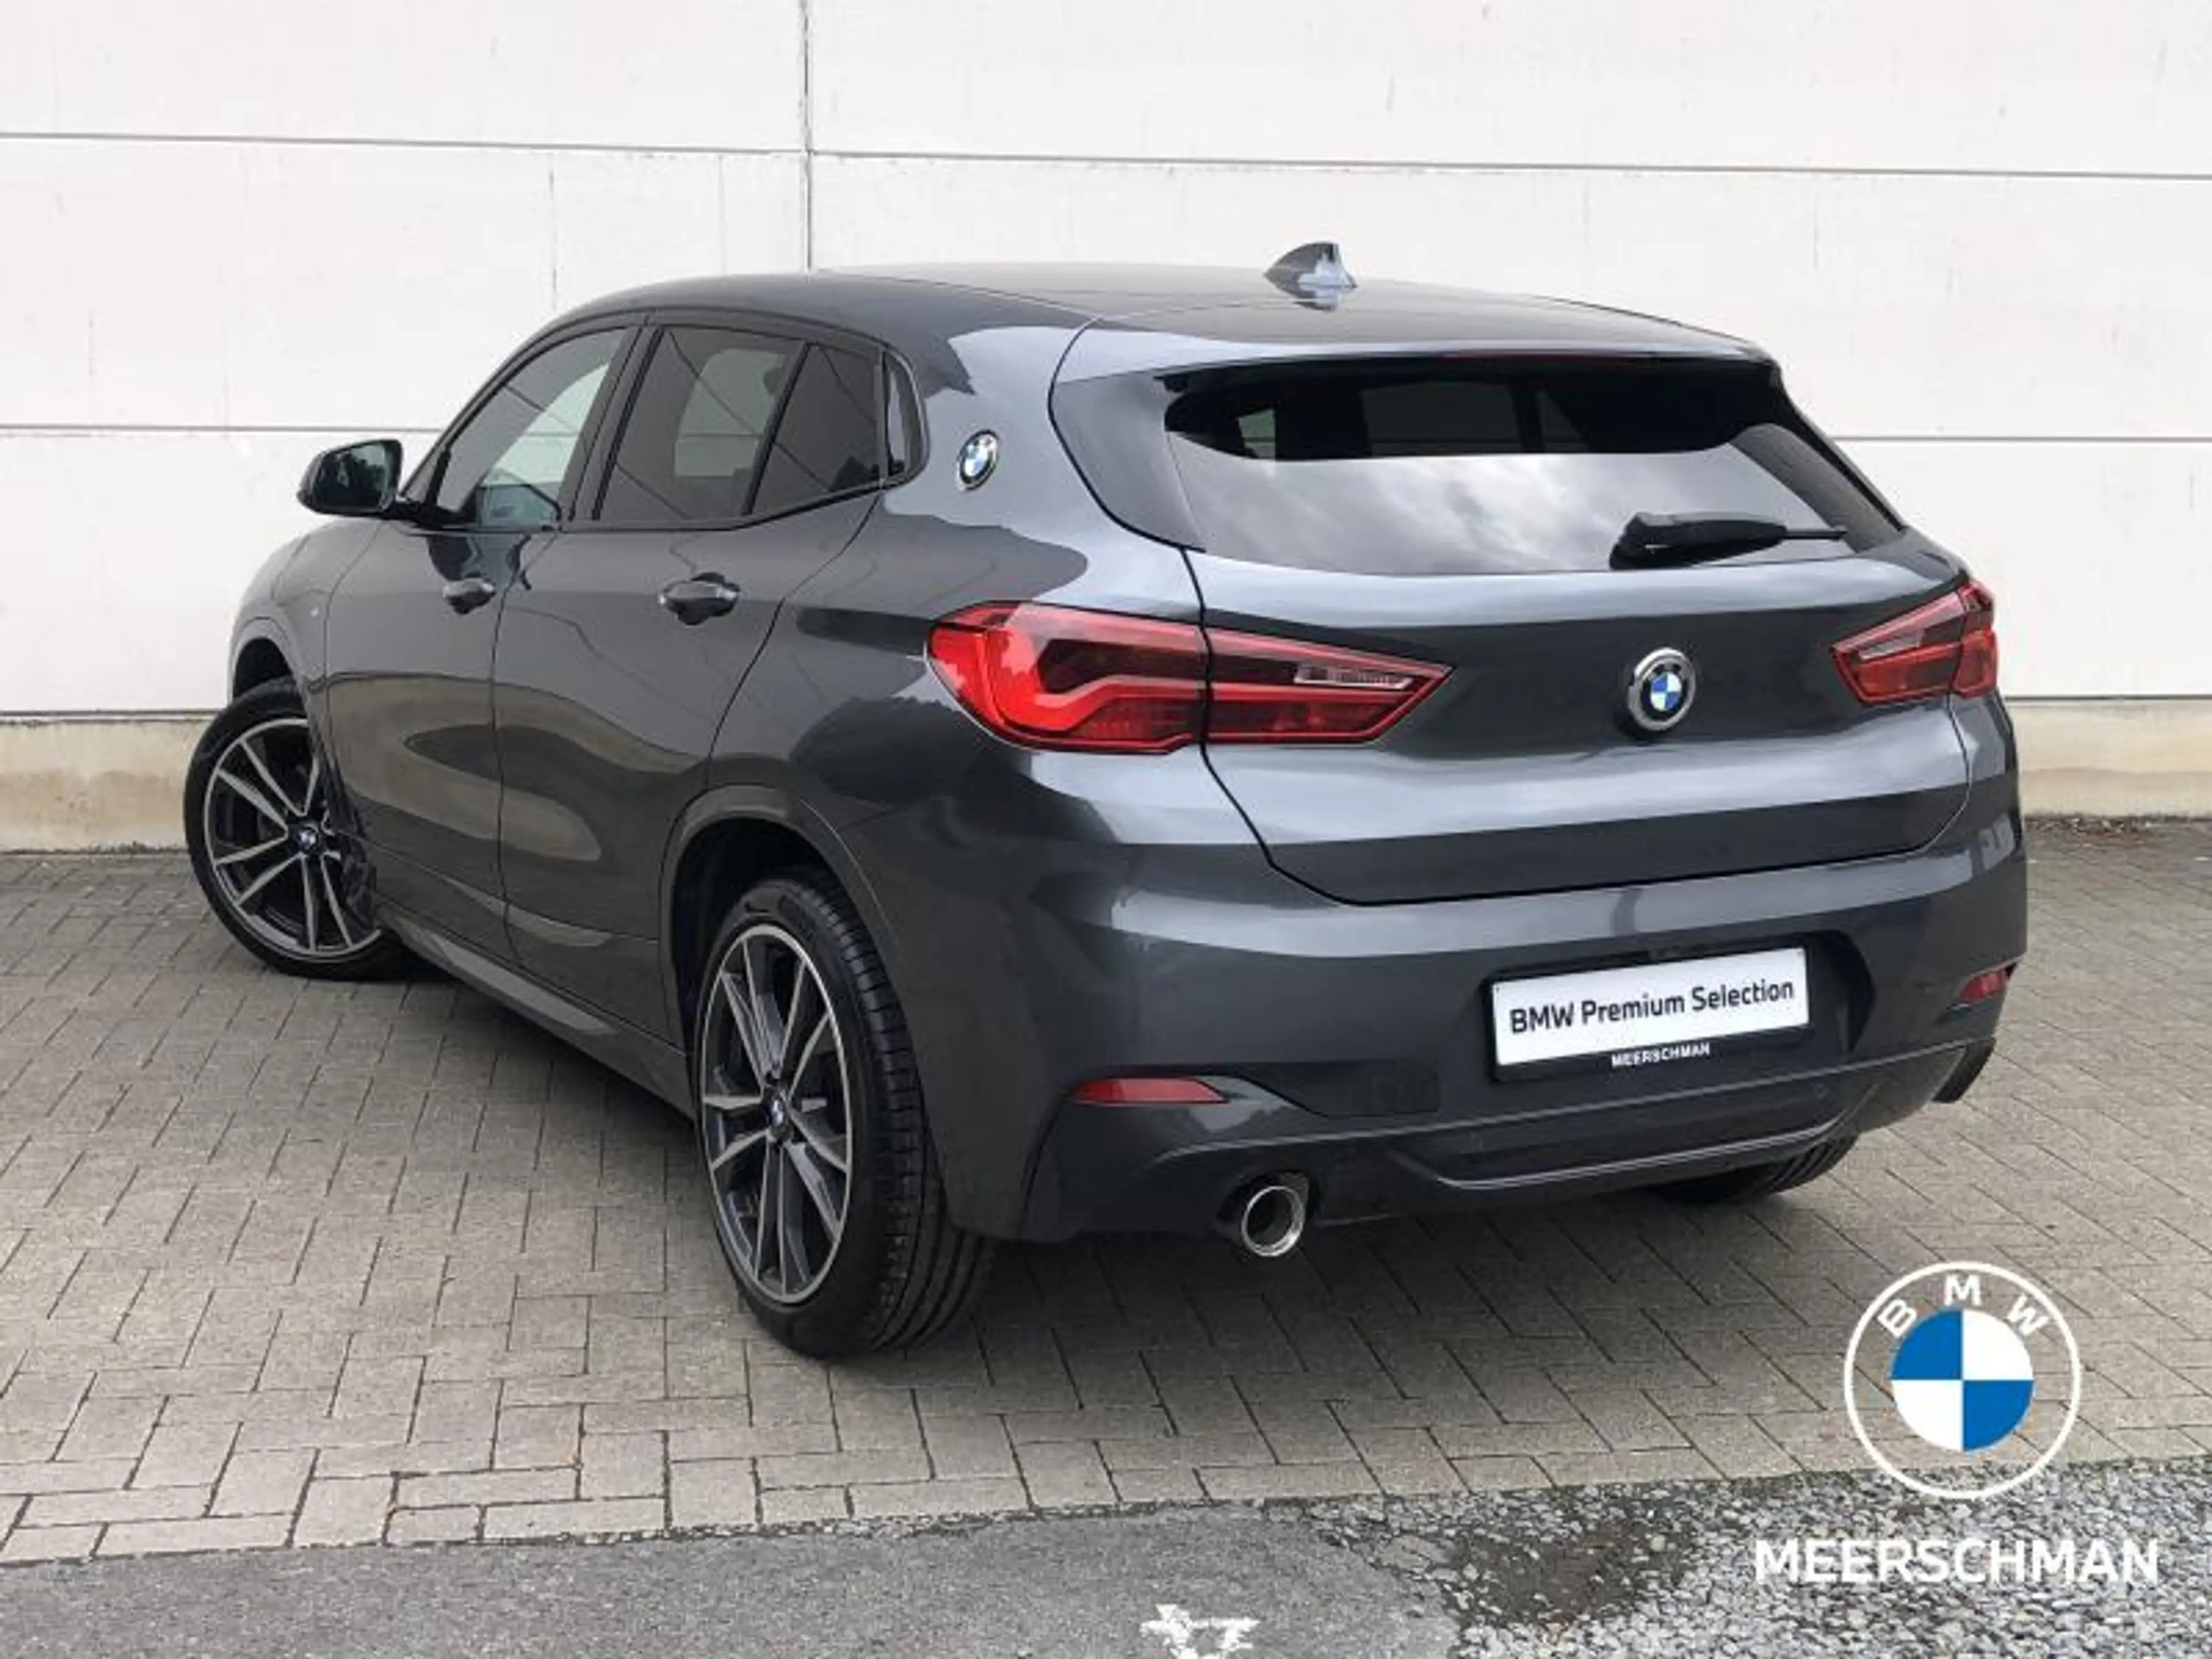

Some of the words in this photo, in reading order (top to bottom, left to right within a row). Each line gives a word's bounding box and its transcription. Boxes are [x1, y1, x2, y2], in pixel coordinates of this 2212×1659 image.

[1510, 1002, 1573, 1033] BMW
[1581, 993, 1684, 1025] Premium
[1692, 978, 1793, 1011] Selection
[1611, 1042, 1710, 1067] MEERSCHMAN
